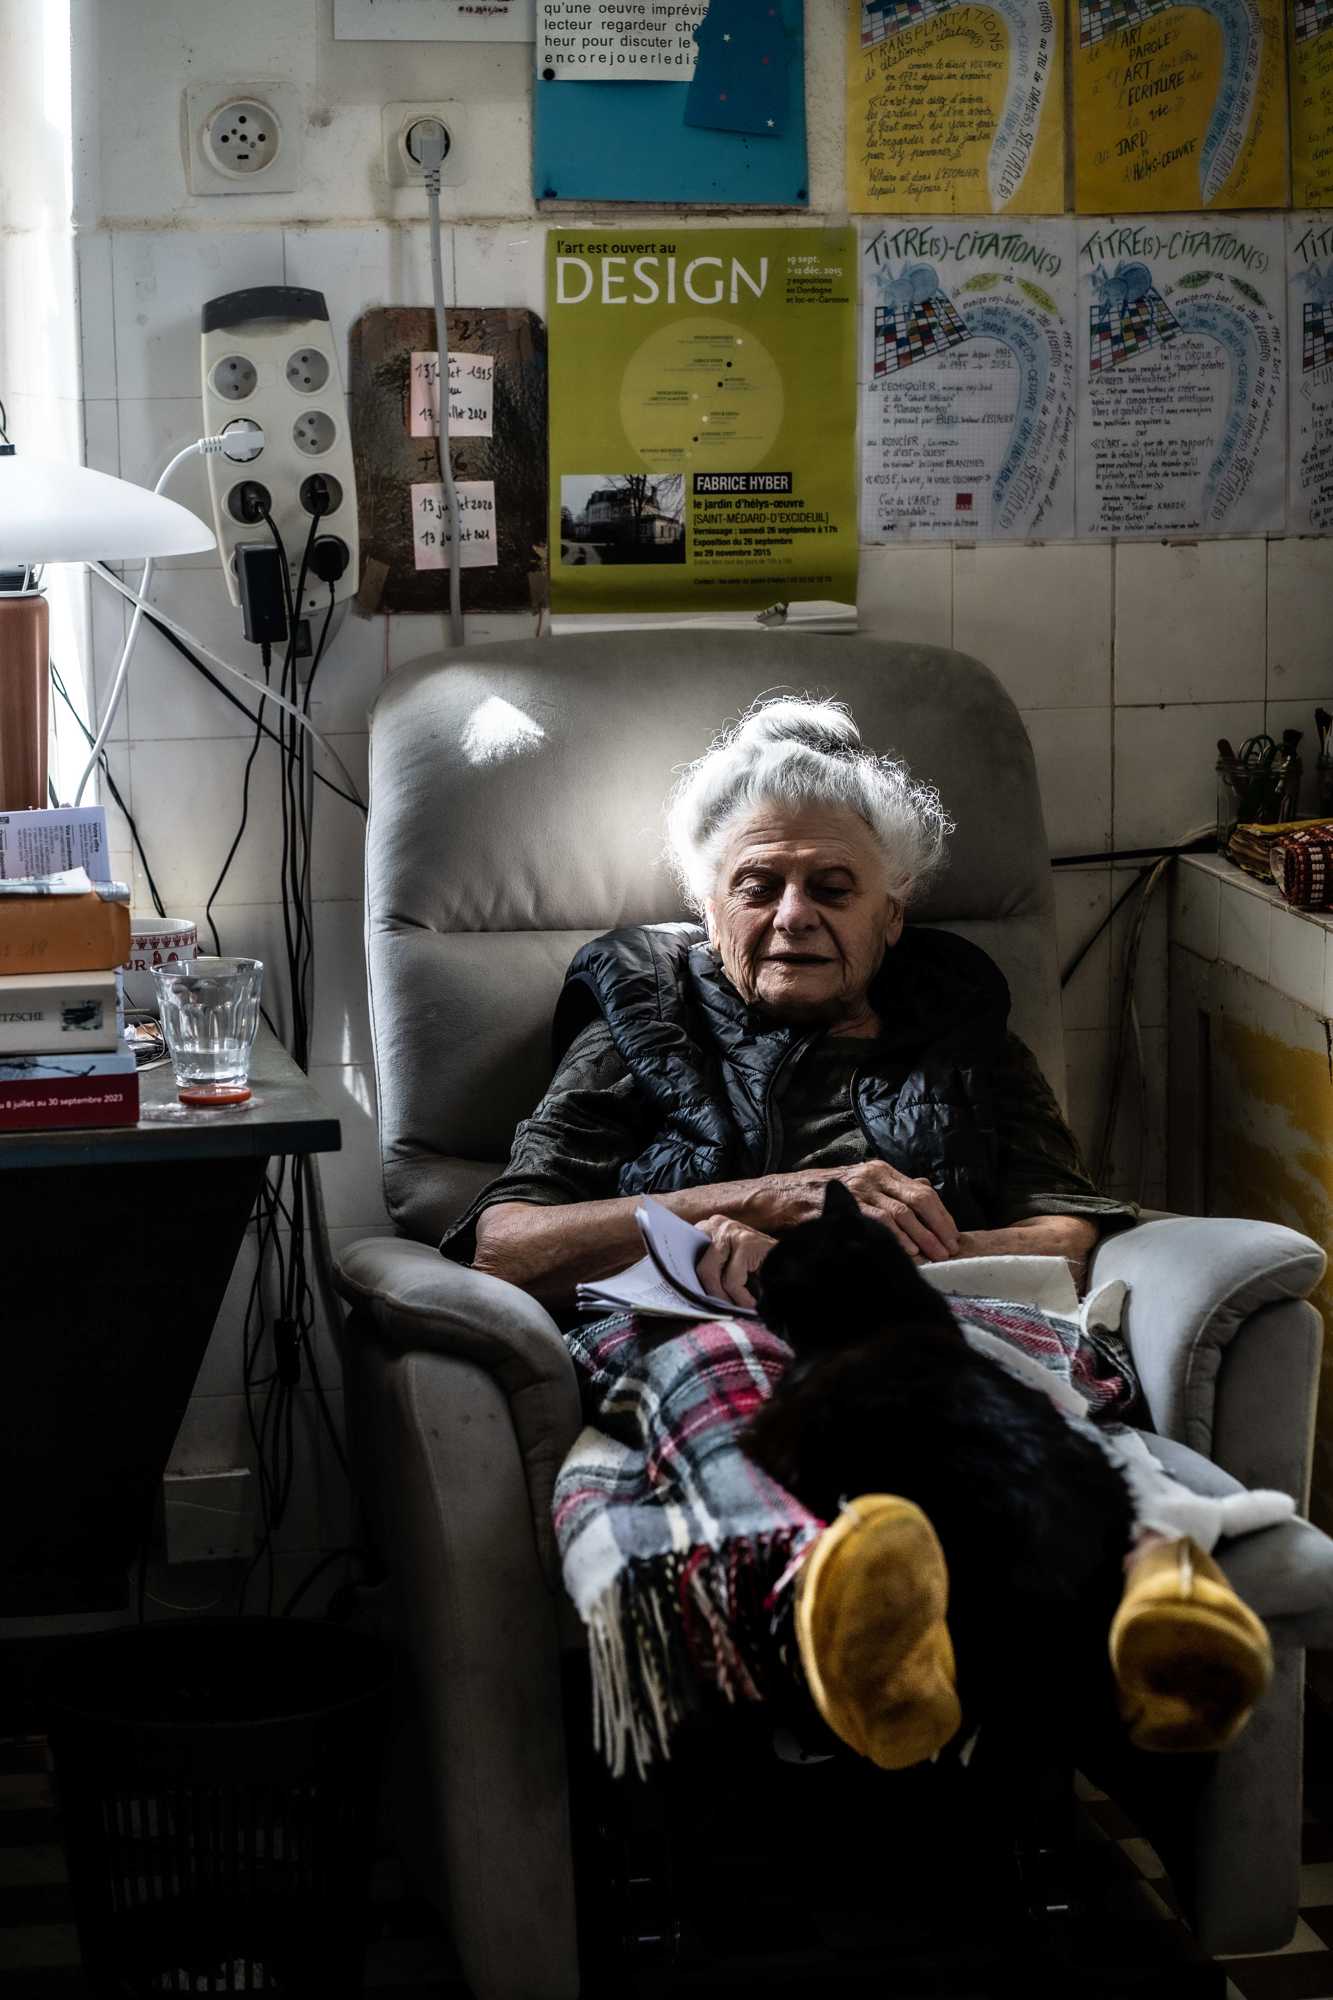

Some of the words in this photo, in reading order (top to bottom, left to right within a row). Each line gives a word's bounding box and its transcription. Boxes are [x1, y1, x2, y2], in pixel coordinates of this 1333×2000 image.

[544, 2, 591, 15] qu'une
[598, 4, 646, 14] oeuvre
[544, 19, 592, 30] lecteur
[601, 20, 667, 32] regardeur
[544, 36, 576, 47] heur
[582, 37, 614, 49] pour
[620, 35, 673, 48] discuter
[679, 37, 690, 48] le
[557, 240, 584, 254] l'art
[587, 243, 608, 254] est
[611, 241, 656, 254] ouvert
[657, 243, 677, 254] au
[556, 256, 768, 304] DESIGN
[697, 476, 746, 490] FABRICE
[750, 476, 788, 490] HYBER
[693, 499, 702, 509] le
[704, 499, 732, 511] jardin
[48, 1097, 59, 1106] 30
[60, 1096, 102, 1108] septembre
